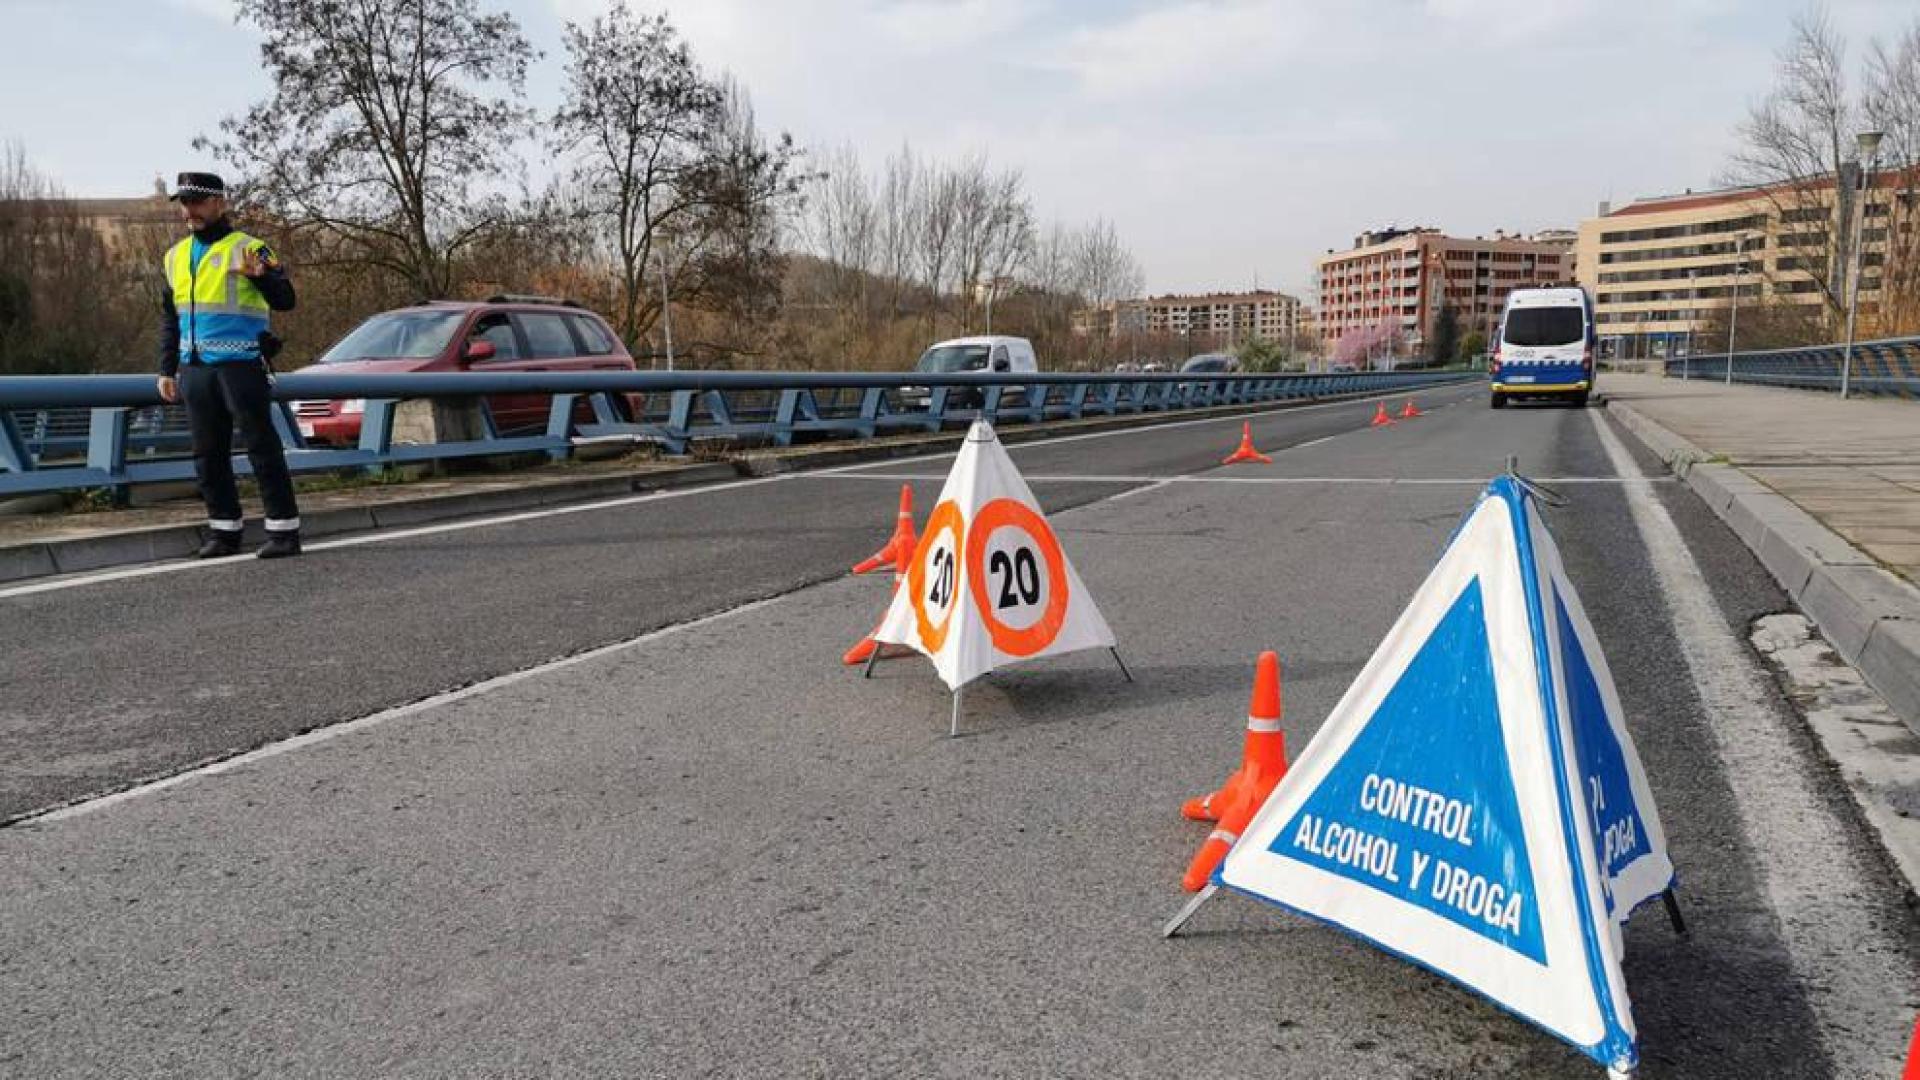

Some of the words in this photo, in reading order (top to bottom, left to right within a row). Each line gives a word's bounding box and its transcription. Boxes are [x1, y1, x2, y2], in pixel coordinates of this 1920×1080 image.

[929, 546, 953, 609] 20
[990, 546, 1041, 610] 20
[1360, 773, 1473, 846] CONTROL
[1293, 814, 1400, 883] ALCOHOL
[1409, 850, 1429, 891] Y
[1432, 861, 1523, 936] DROGA
